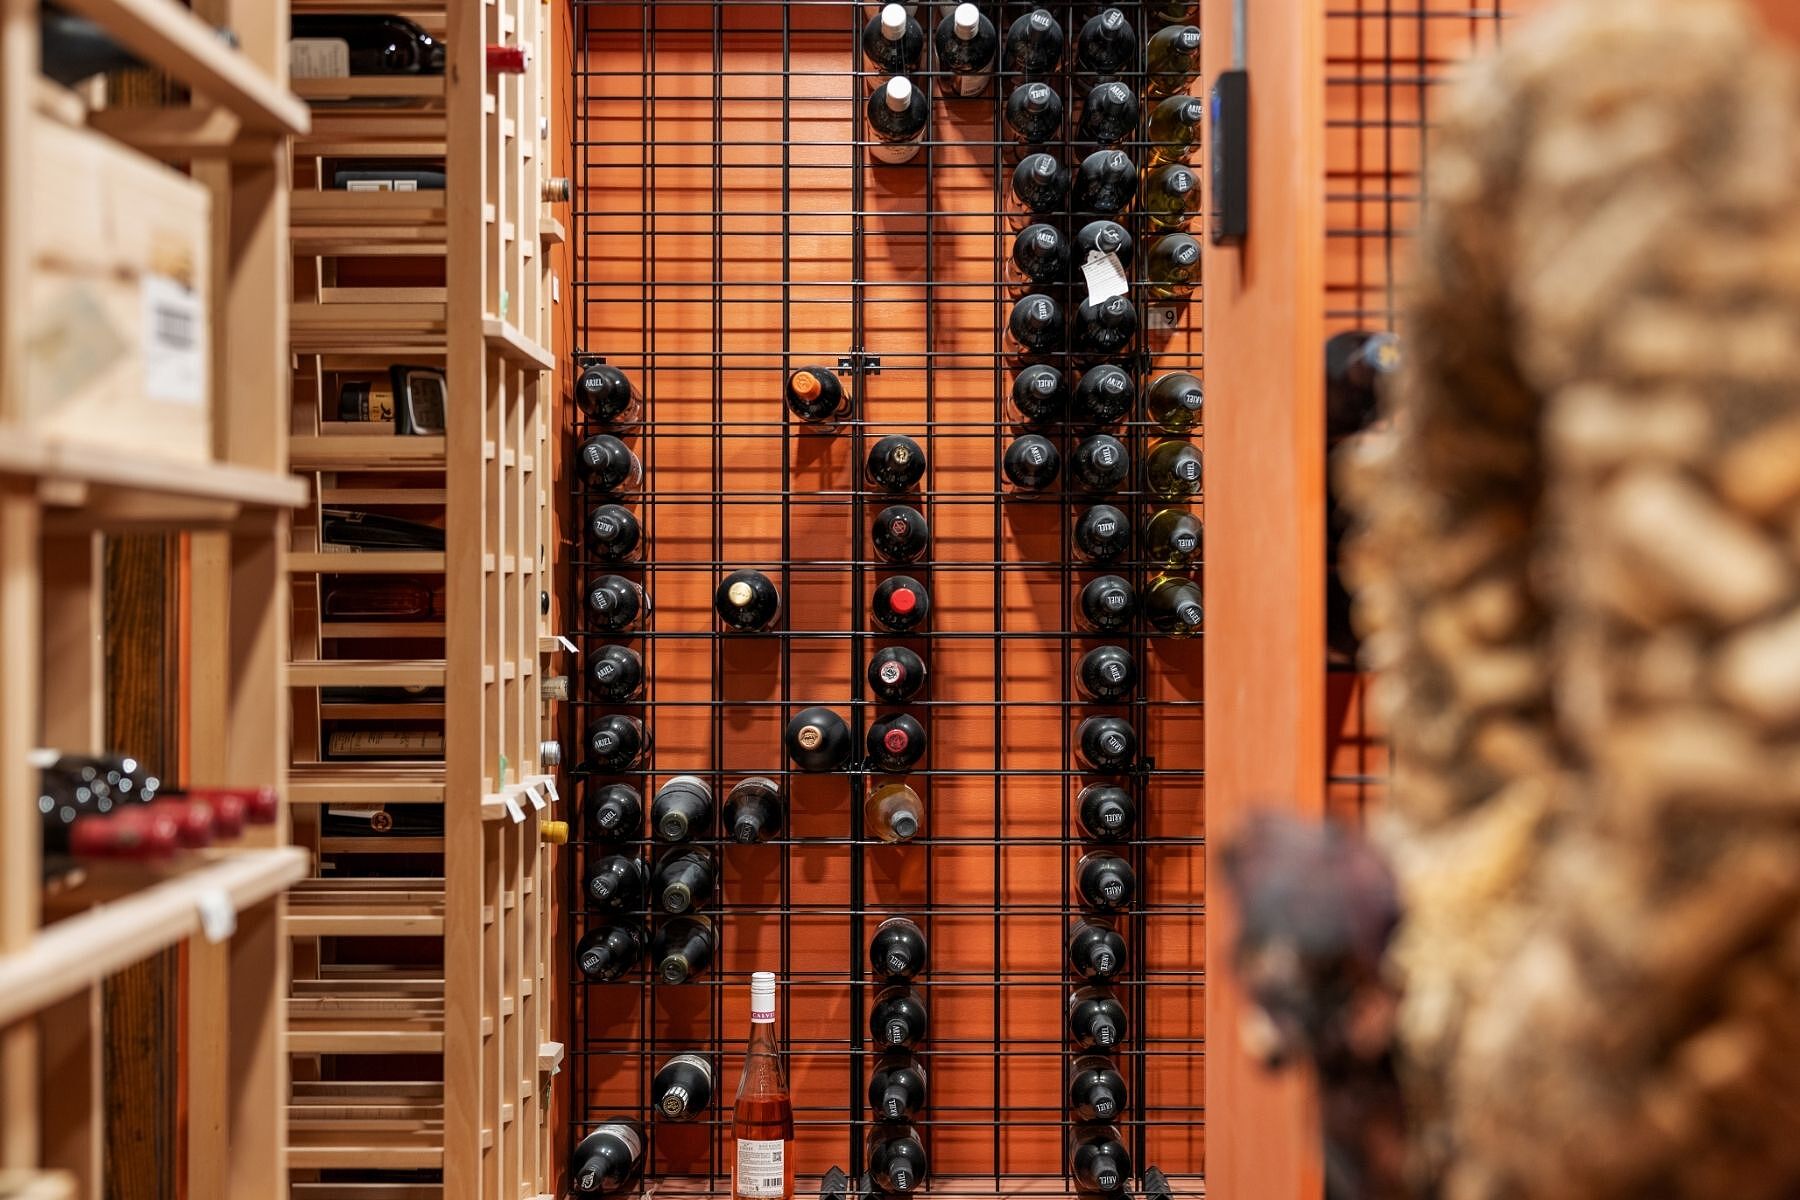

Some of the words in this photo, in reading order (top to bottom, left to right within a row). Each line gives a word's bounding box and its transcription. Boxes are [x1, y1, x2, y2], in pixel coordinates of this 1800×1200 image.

[1032, 15, 1049, 27] ARIEL
[1108, 11, 1121, 28] ARIEL
[1030, 89, 1048, 98] ARIEL
[1110, 86, 1126, 102] ARIEL
[1178, 173, 1187, 191] ARIEL
[1037, 233, 1055, 245] ARIEL
[1179, 247, 1196, 260] ARIEL
[1038, 302, 1047, 319] ARIEL
[1165, 310, 1175, 325] 9
[585, 378, 603, 387] ARIEL
[1038, 379, 1055, 388] ARIEL
[1106, 377, 1123, 390] ARIEL
[588, 446, 600, 464] ARIEL
[1031, 447, 1043, 464] ARIEL
[1102, 446, 1112, 464] ARIEL
[1186, 462, 1195, 480] ARIEL
[596, 521, 613, 532] ARIEL
[1097, 522, 1115, 532] ARIEL
[1178, 538, 1195, 547] ARIEL
[594, 591, 607, 609] ARIEL
[1107, 595, 1125, 604] ARIEL
[1186, 607, 1200, 624] ARIEL
[597, 663, 614, 678] ARIEL
[1109, 664, 1120, 682] ARIEL
[594, 737, 612, 749] ARIEL
[600, 810, 617, 825] ARIEL
[1104, 813, 1123, 822] ARIEL
[1104, 885, 1122, 895] ARIEL
[583, 955, 600, 970] ARIEL
[892, 1025, 901, 1043] ARIEL
[1101, 1025, 1110, 1044] ARIEL
[888, 1098, 898, 1117] ARIEL
[1095, 1101, 1113, 1112] ARIEL
[897, 1171, 907, 1189] ARIEL
[1098, 1175, 1117, 1185] ARIEL
